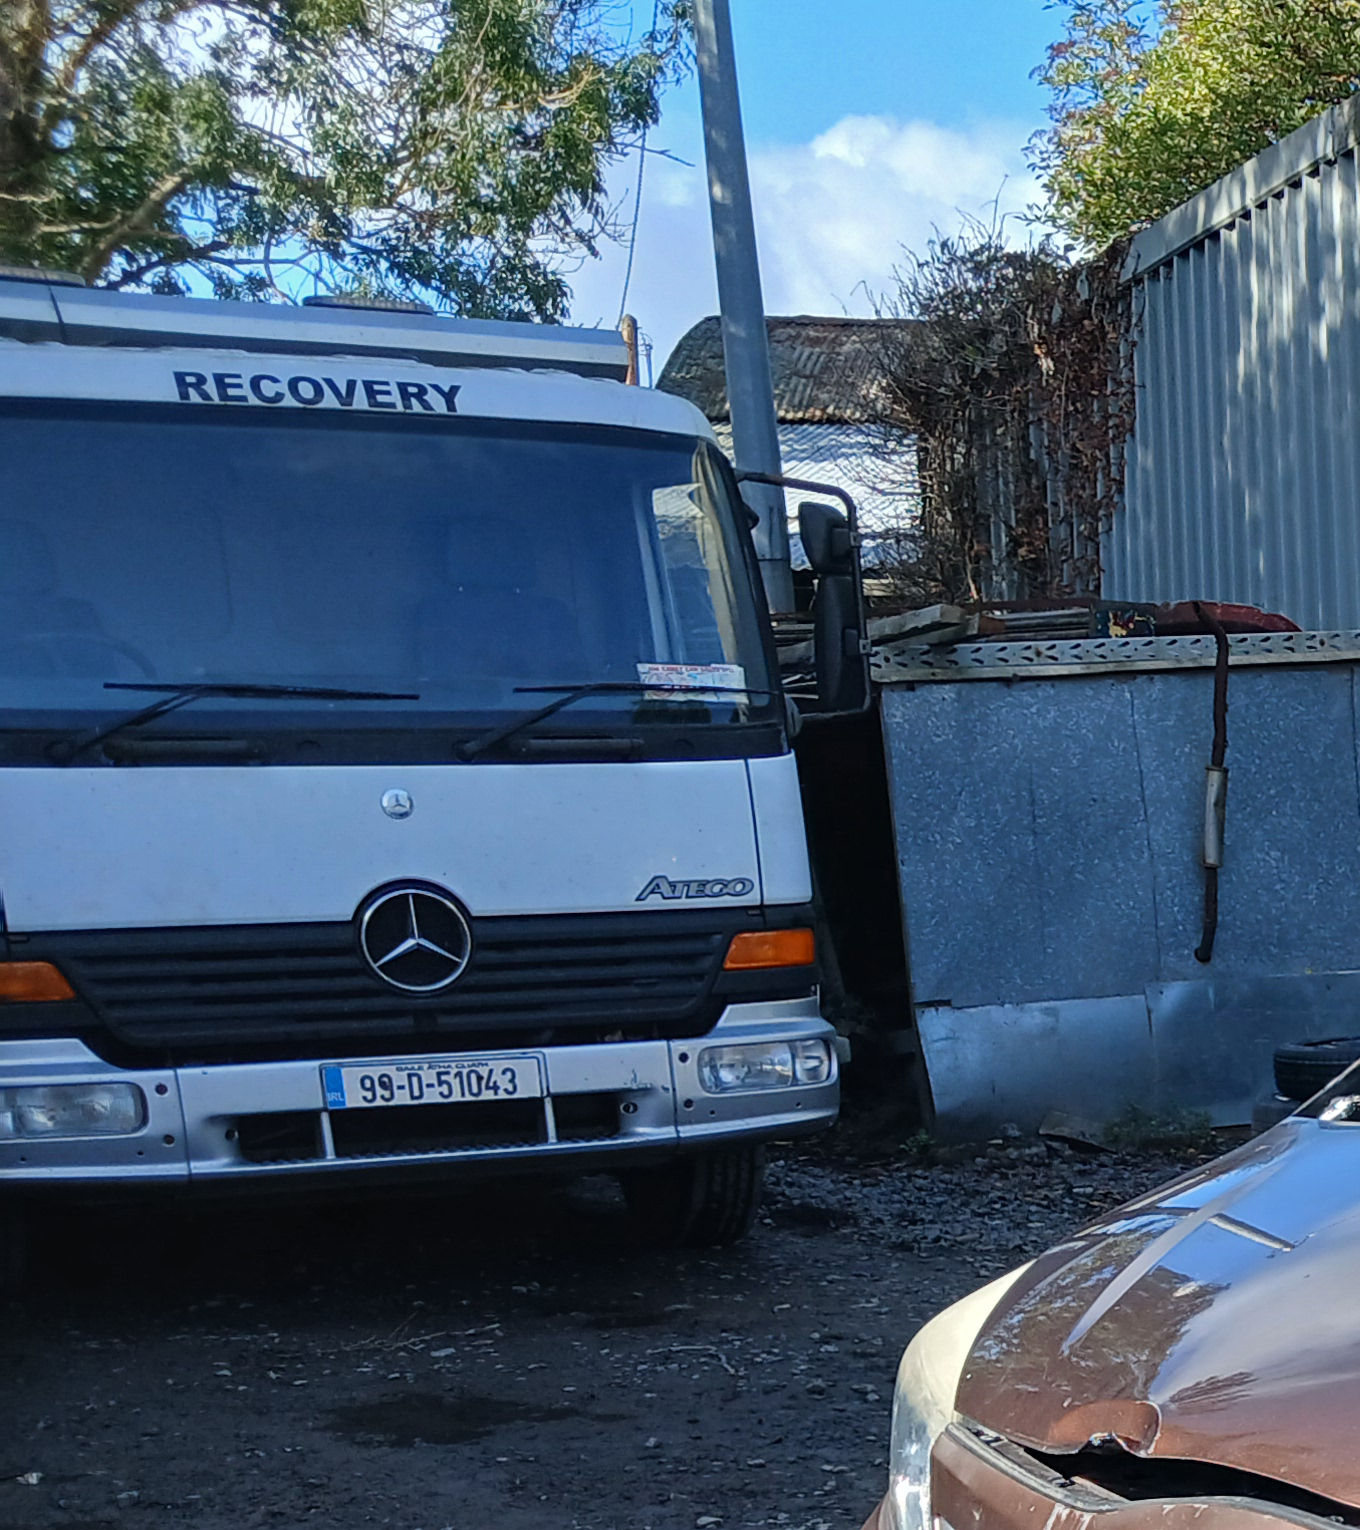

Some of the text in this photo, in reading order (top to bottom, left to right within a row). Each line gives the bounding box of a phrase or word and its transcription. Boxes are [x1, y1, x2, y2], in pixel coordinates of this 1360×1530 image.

[173, 371, 461, 413] RECOVERY
[635, 875, 754, 901] ATEGO
[327, 1092, 345, 1102] IRL
[360, 1067, 518, 1103] 99-D-51043
